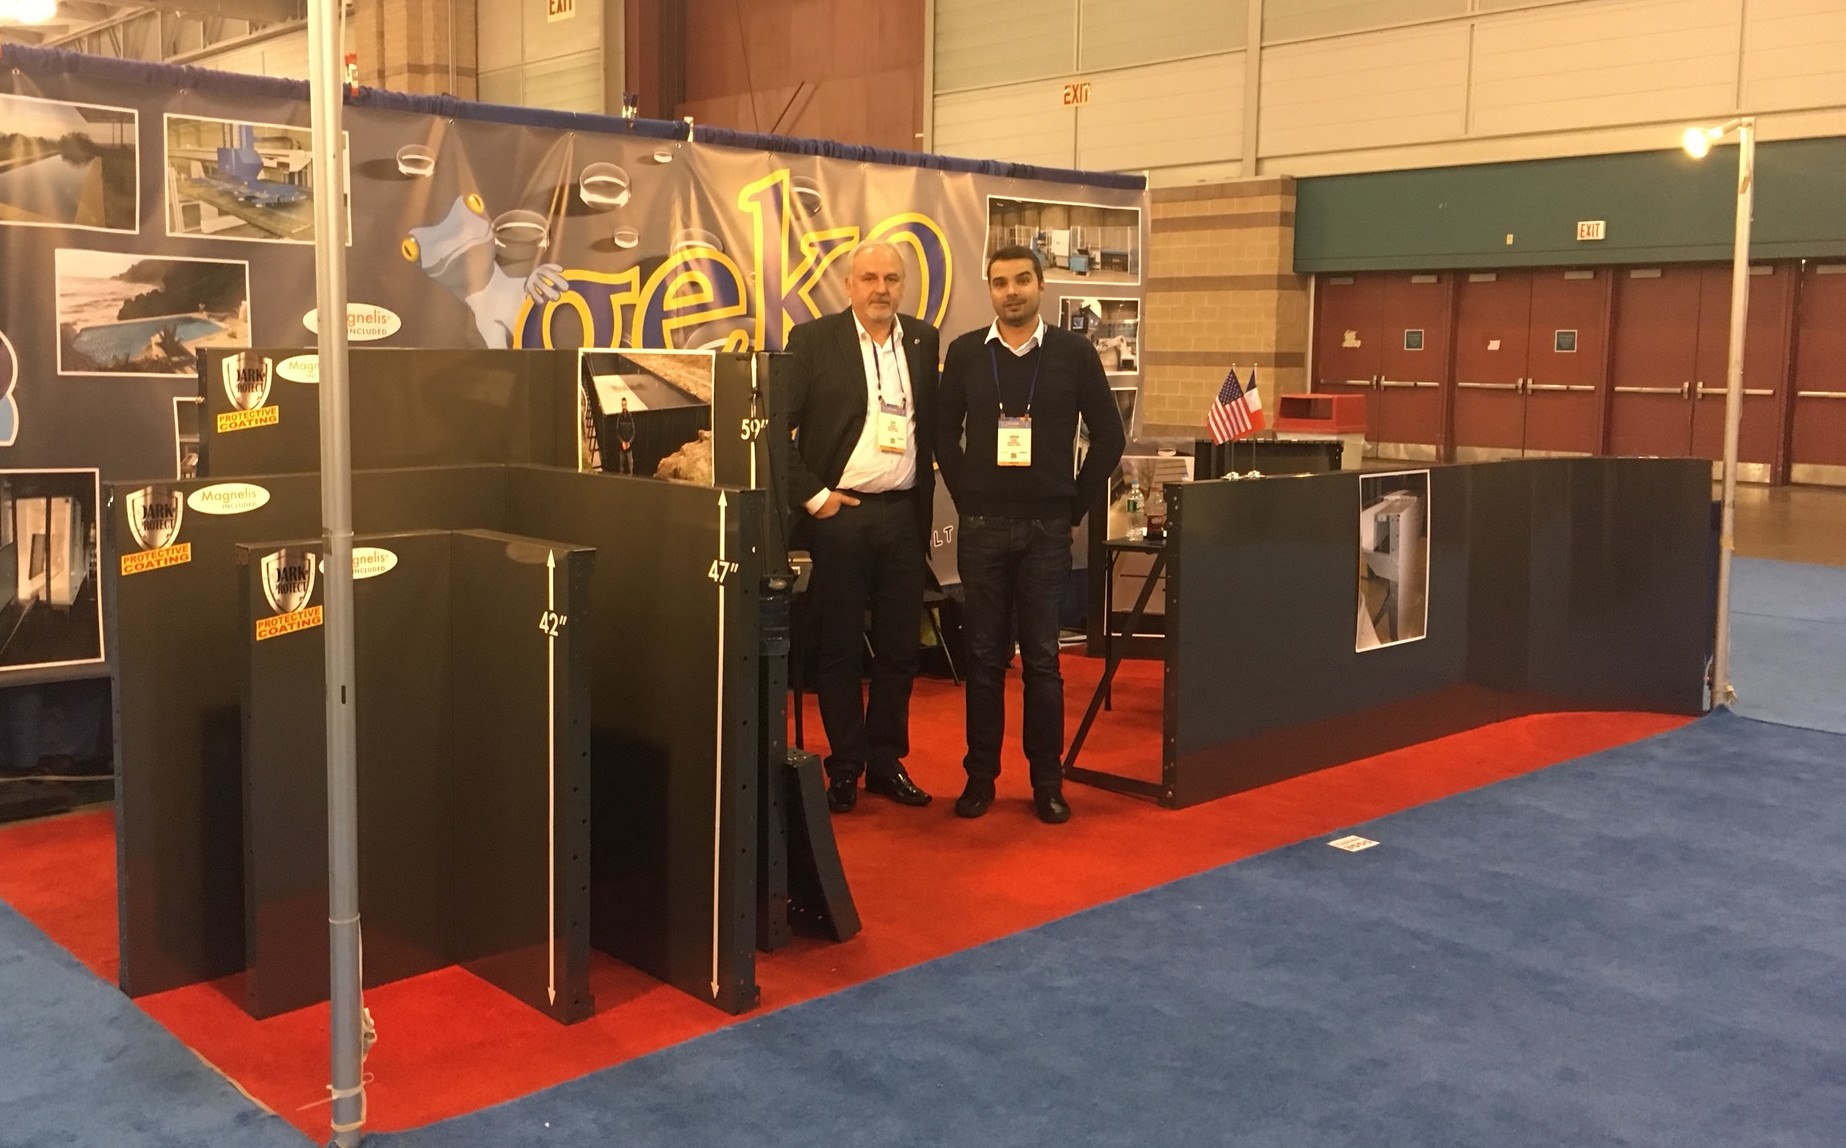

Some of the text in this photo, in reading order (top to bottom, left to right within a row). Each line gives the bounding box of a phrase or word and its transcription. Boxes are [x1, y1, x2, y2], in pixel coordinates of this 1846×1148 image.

[1063, 82, 1091, 105] EXIT
[1580, 223, 1600, 238] EXIT
[219, 407, 277, 423] PROTECTIVE
[219, 415, 277, 431] COATING
[222, 501, 258, 509] INCLUDED
[123, 545, 189, 565] PROTECTIVE
[123, 553, 190, 573] COATING
[708, 559, 739, 584] 47"
[258, 606, 321, 629] PROTECTIVE
[258, 616, 322, 638] COATING
[539, 611, 567, 637] 42"
